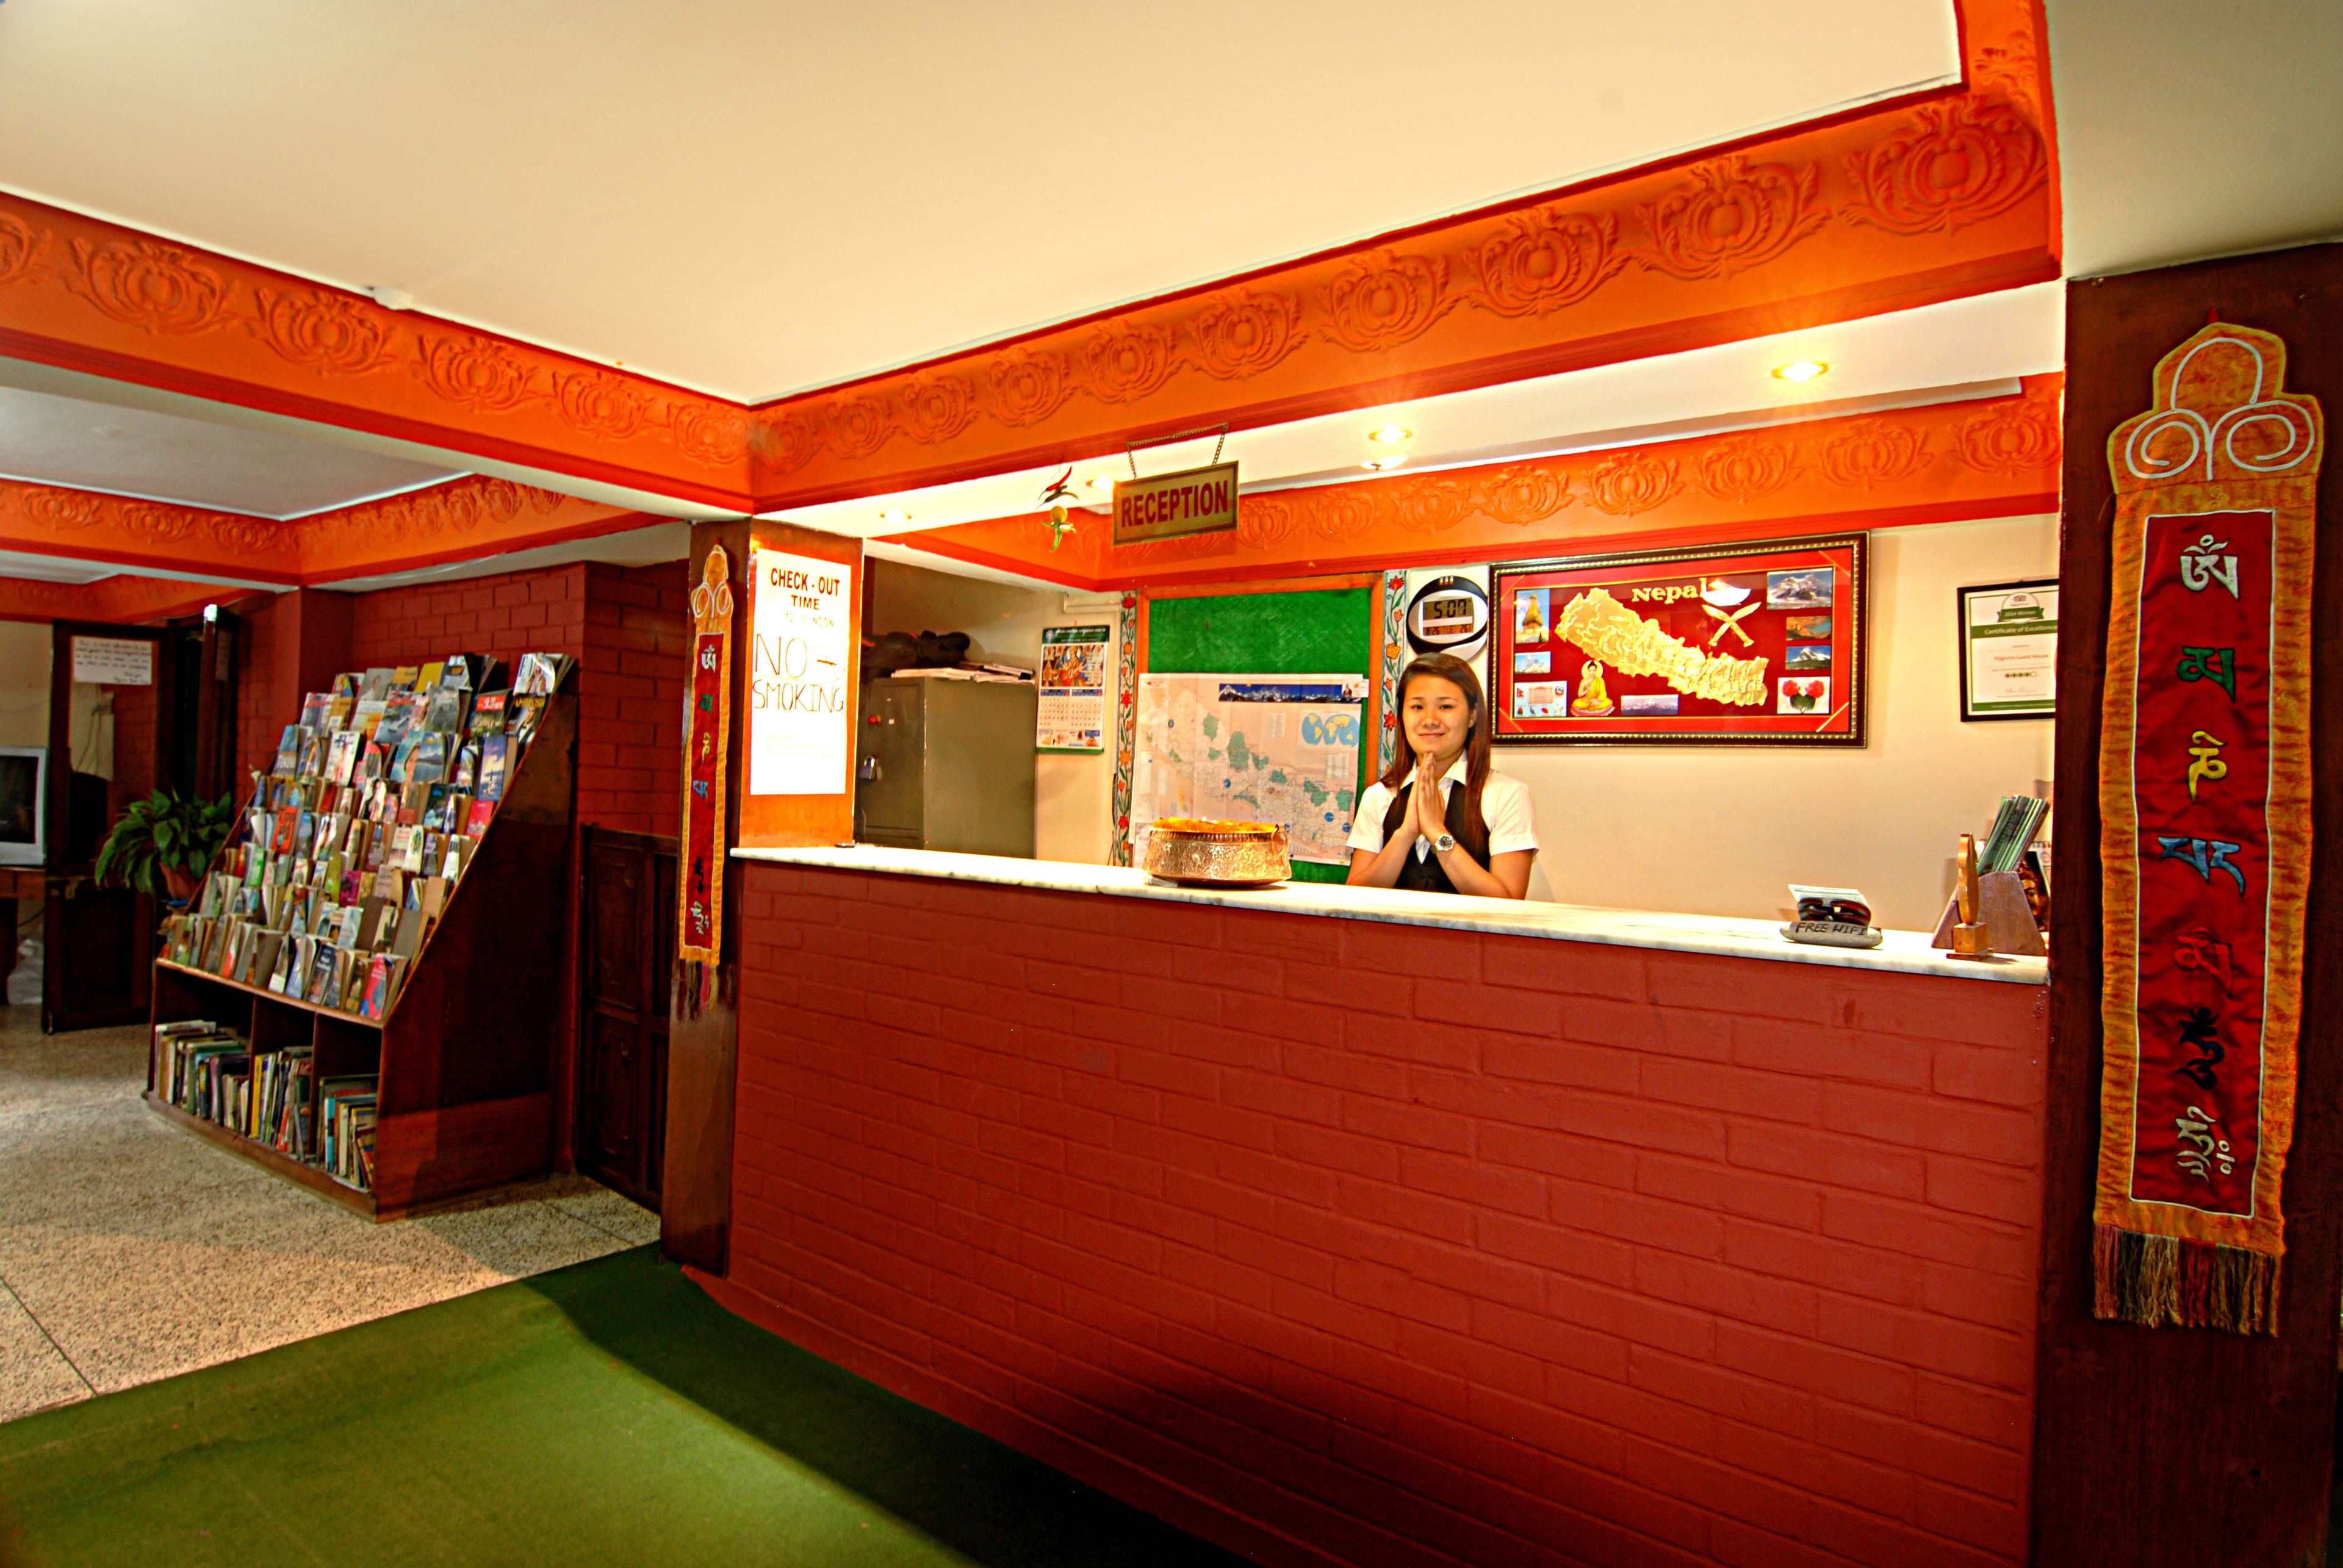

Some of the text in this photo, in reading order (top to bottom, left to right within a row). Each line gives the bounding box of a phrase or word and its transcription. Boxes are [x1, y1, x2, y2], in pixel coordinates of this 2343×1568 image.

[1121, 480, 1228, 528] RECEPTION
[771, 567, 808, 591] CHECK
[818, 577, 840, 596] OUT
[1632, 577, 1707, 605] Nepal
[791, 595, 819, 610] TIME
[755, 633, 807, 678] NO
[752, 679, 844, 714] SMOKING
[1795, 922, 1868, 936] FREE WIFI
